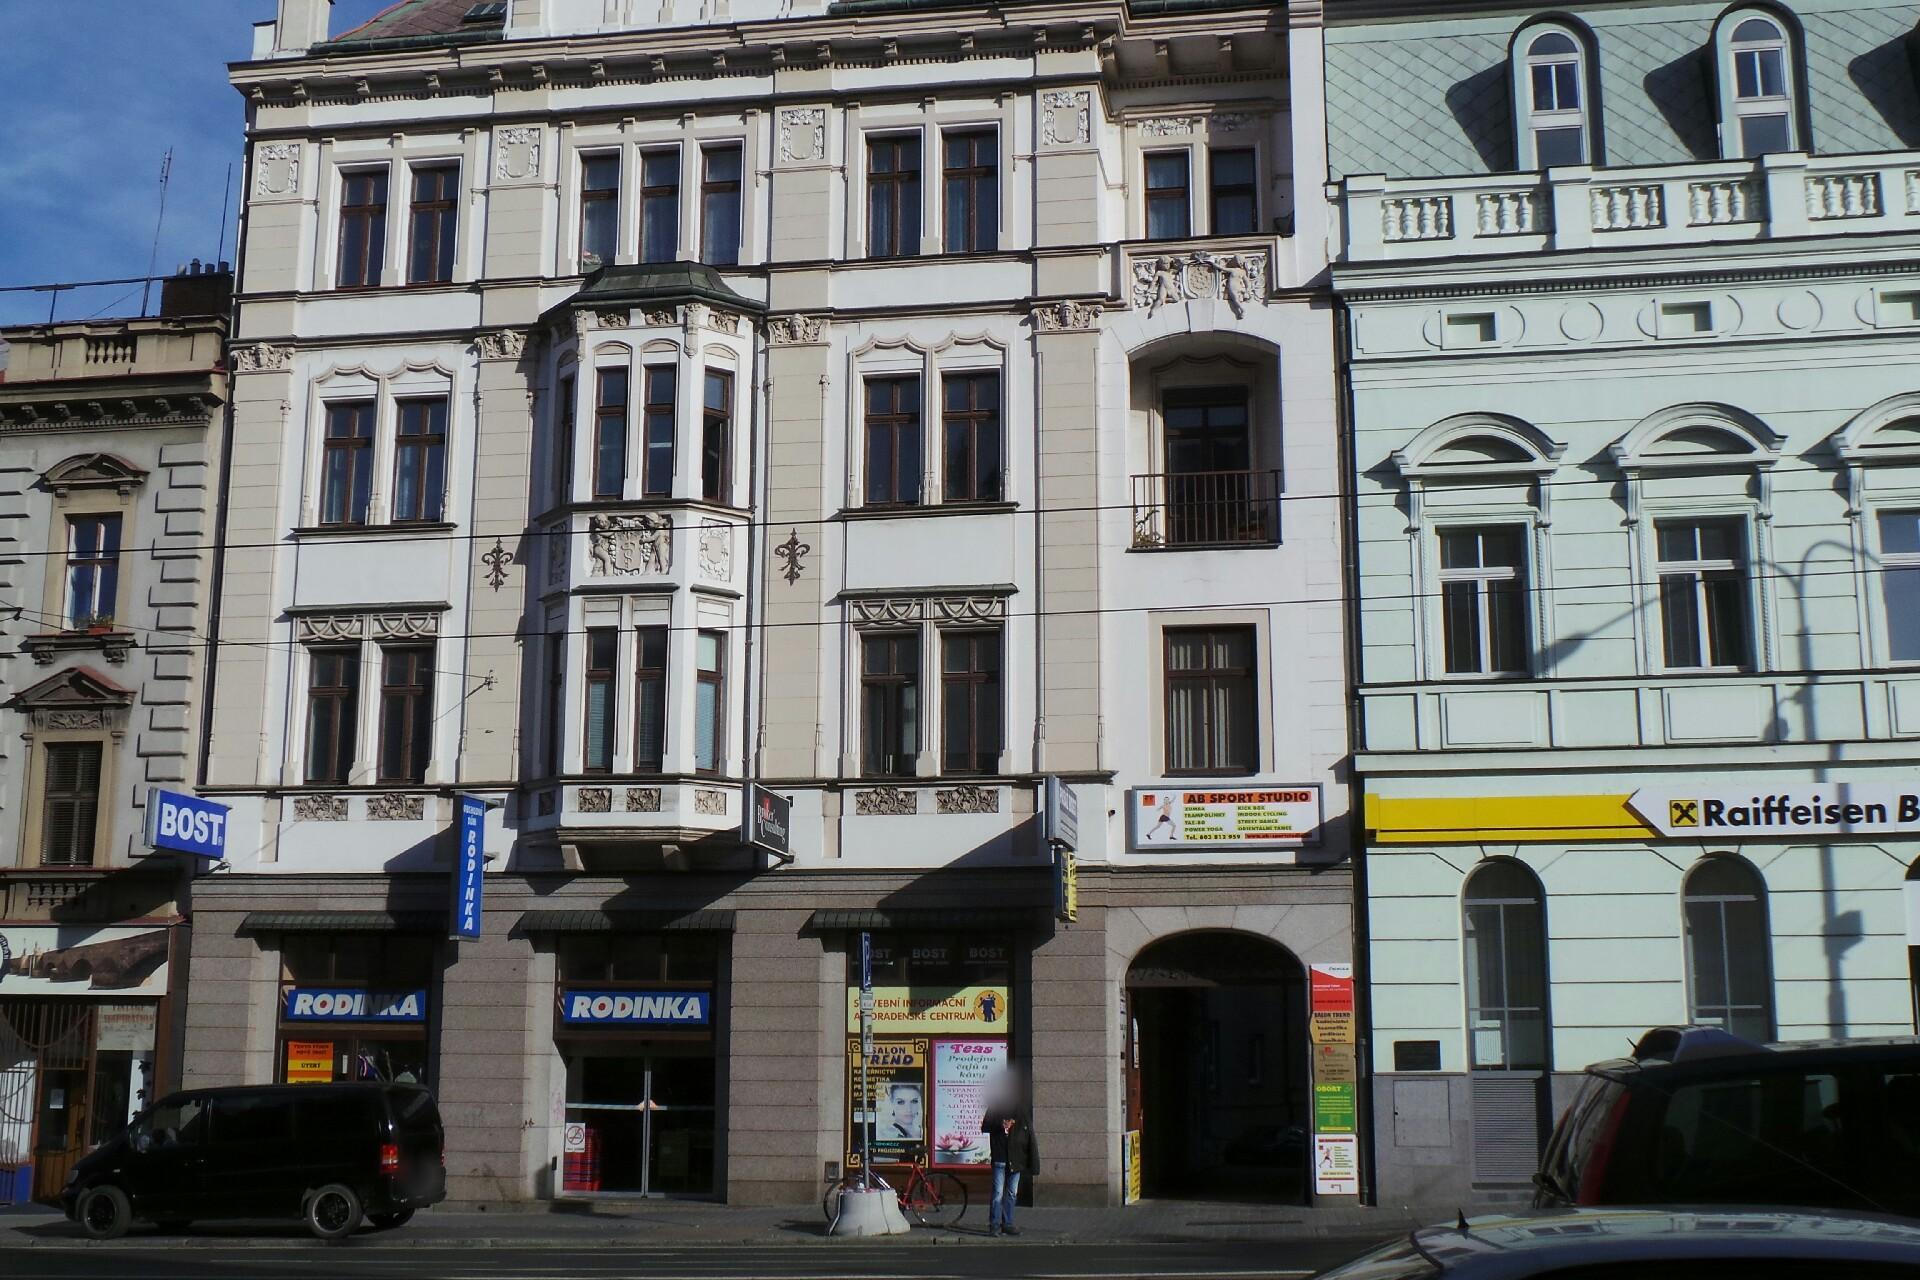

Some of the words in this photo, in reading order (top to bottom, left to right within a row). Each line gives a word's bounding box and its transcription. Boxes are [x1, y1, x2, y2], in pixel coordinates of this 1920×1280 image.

[1187, 794, 1206, 803] AB
[1210, 793, 1254, 803] SPORT
[1259, 792, 1309, 802] STUDIO
[1703, 795, 1887, 826] Raiffeisen
[160, 803, 223, 845] BOST
[463, 830, 476, 930] RODINKA
[912, 949, 947, 958] BOST
[969, 948, 1004, 958] BOST
[294, 993, 418, 1015] RODINKA
[571, 996, 701, 1018] RODINKA
[903, 996, 966, 1008] INFORMAČNÍ
[930, 1012, 976, 1021] CENTRUM
[951, 1044, 993, 1054] Teas
